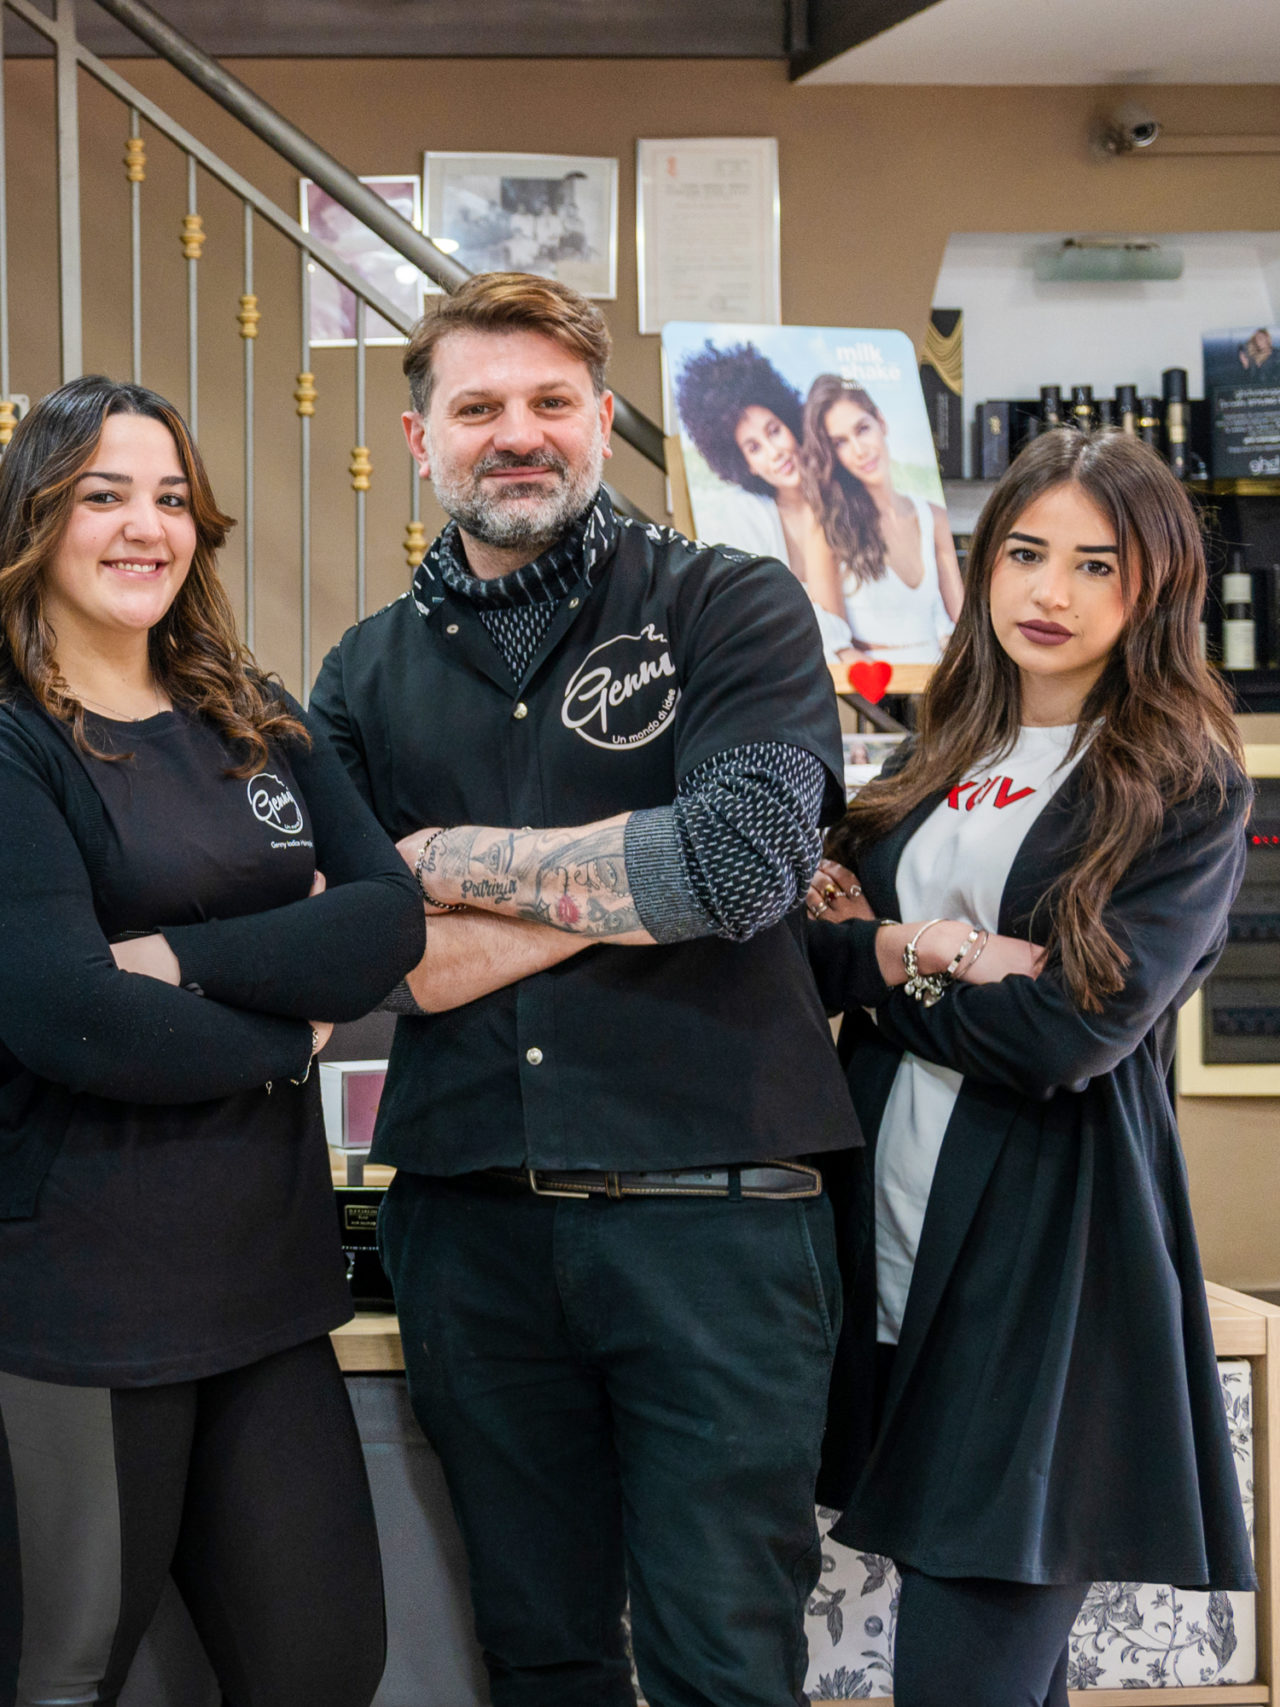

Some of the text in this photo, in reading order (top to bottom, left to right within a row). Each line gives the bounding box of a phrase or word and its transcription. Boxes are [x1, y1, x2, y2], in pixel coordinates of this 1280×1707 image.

[835, 341, 884, 363] milk
[839, 361, 901, 380] shake
[611, 734, 627, 745] Un
[629, 719, 659, 744] mondo
[658, 710, 668, 721] di
